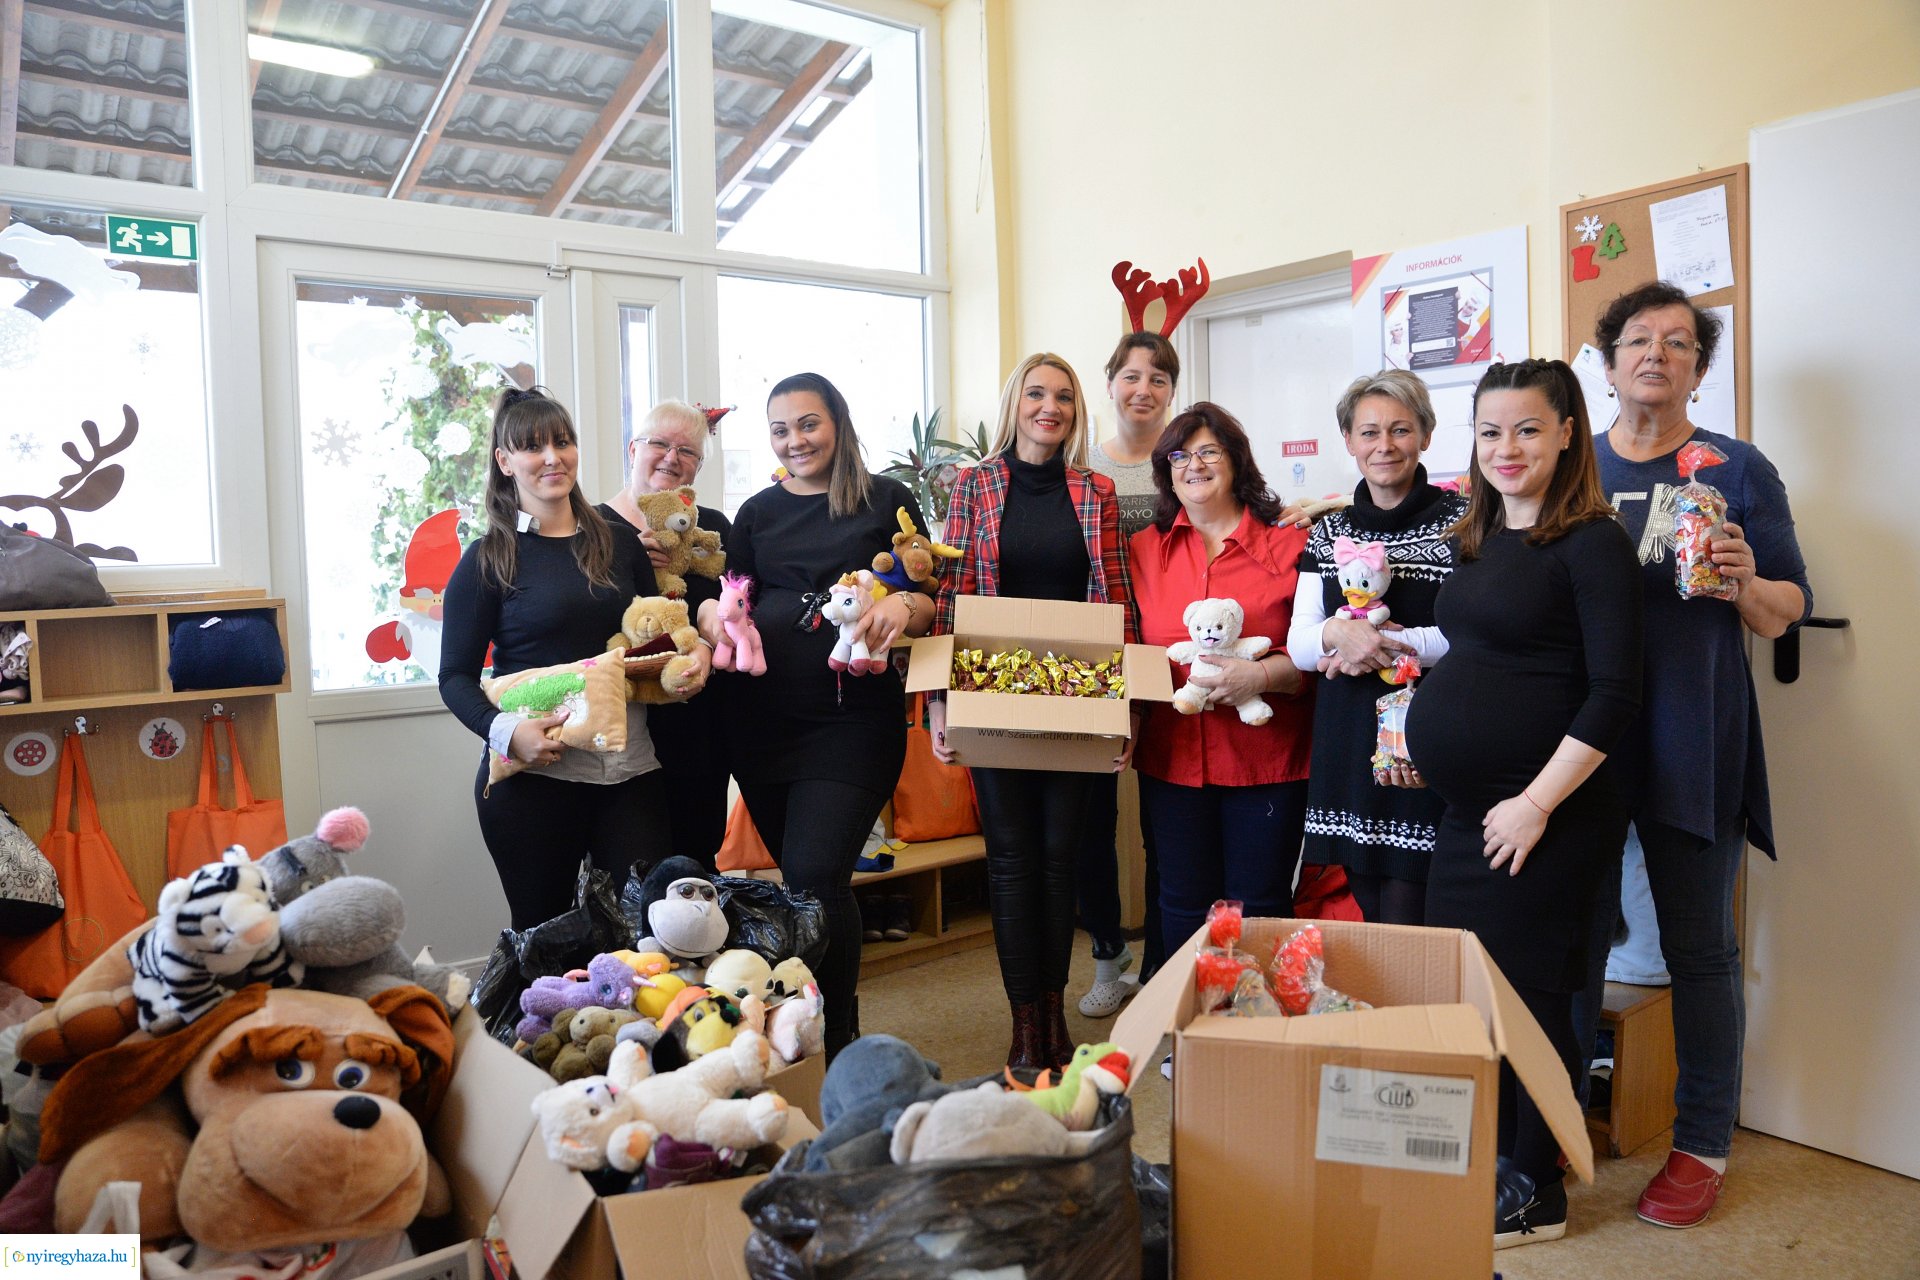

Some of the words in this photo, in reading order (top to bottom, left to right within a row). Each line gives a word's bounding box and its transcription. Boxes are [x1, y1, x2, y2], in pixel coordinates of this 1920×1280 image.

[1406, 254, 1463, 272] INFORMÁCIÓK
[1286, 443, 1315, 454] IRODA
[1120, 508, 1153, 519] OKYO
[1424, 1085, 1468, 1097] ELEGANT
